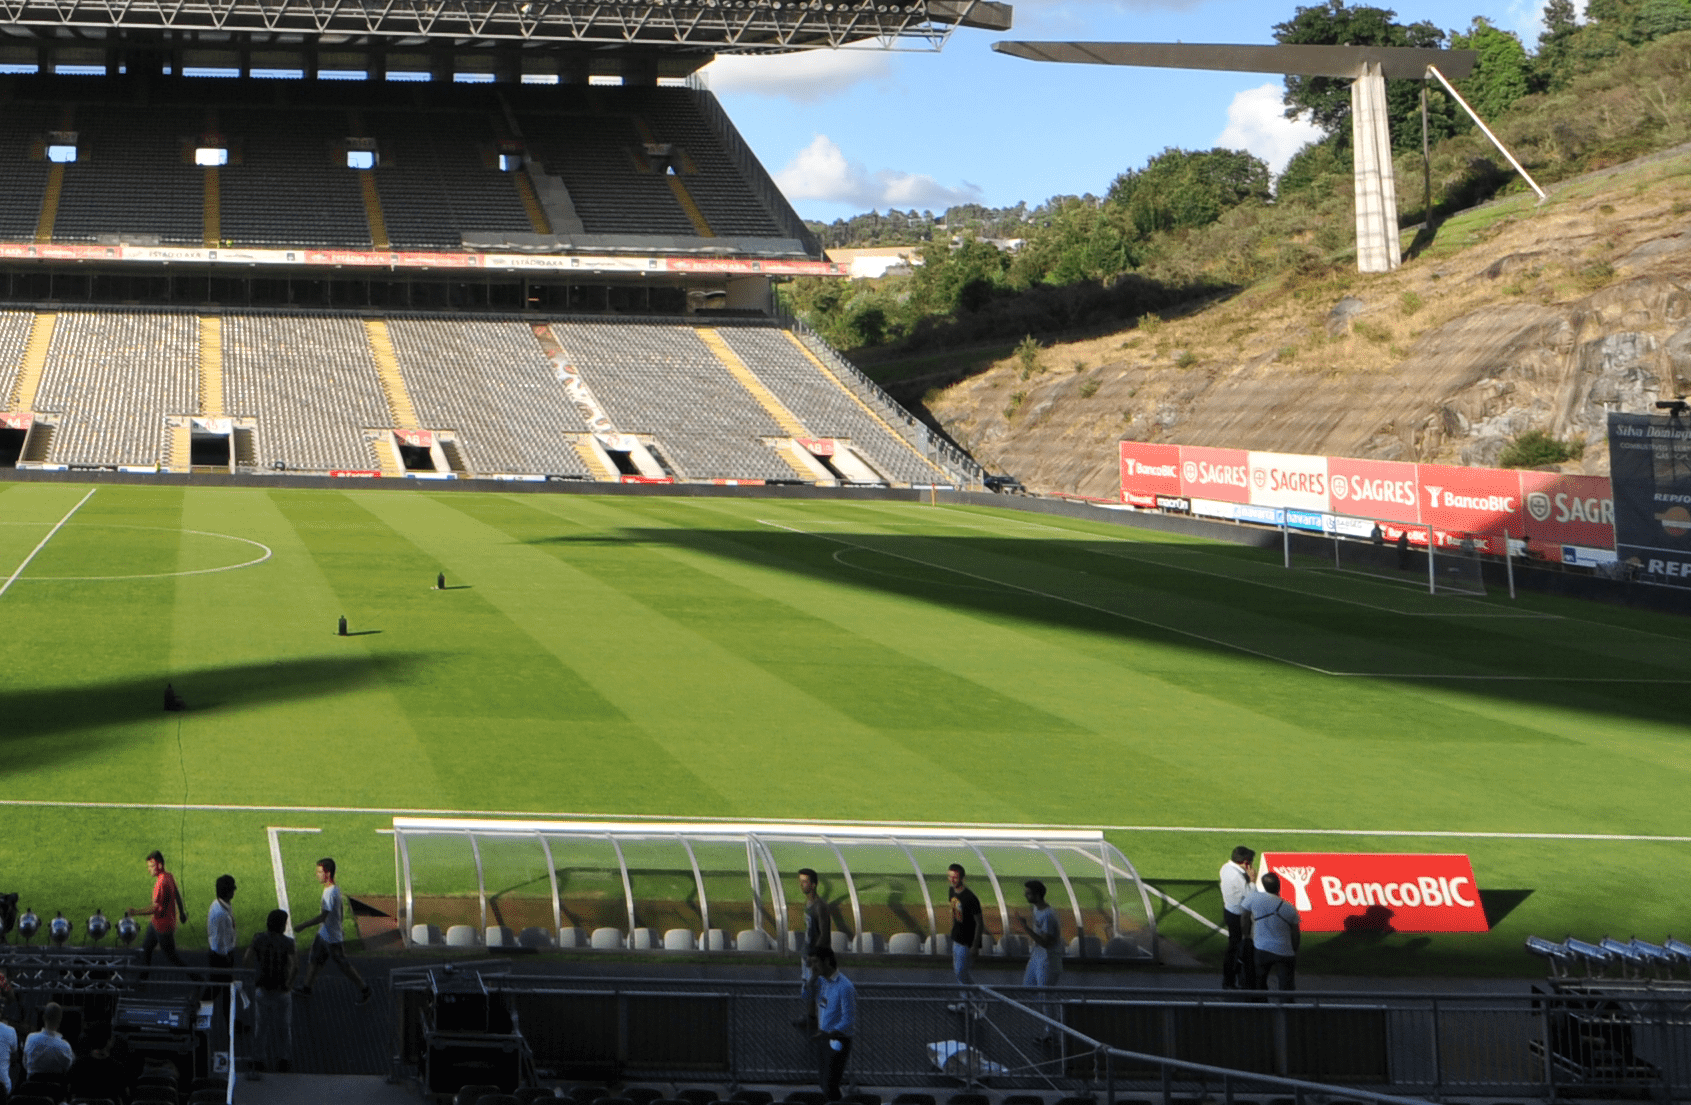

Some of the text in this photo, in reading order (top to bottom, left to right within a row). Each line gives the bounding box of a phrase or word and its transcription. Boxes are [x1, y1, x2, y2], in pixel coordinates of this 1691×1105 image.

[1199, 461, 1248, 487] SAGRES
[1271, 469, 1325, 496] SAGRES
[1351, 475, 1416, 506] SAGRES
[1444, 491, 1516, 513] BancoBIC
[1320, 875, 1476, 908] BancoBIC
